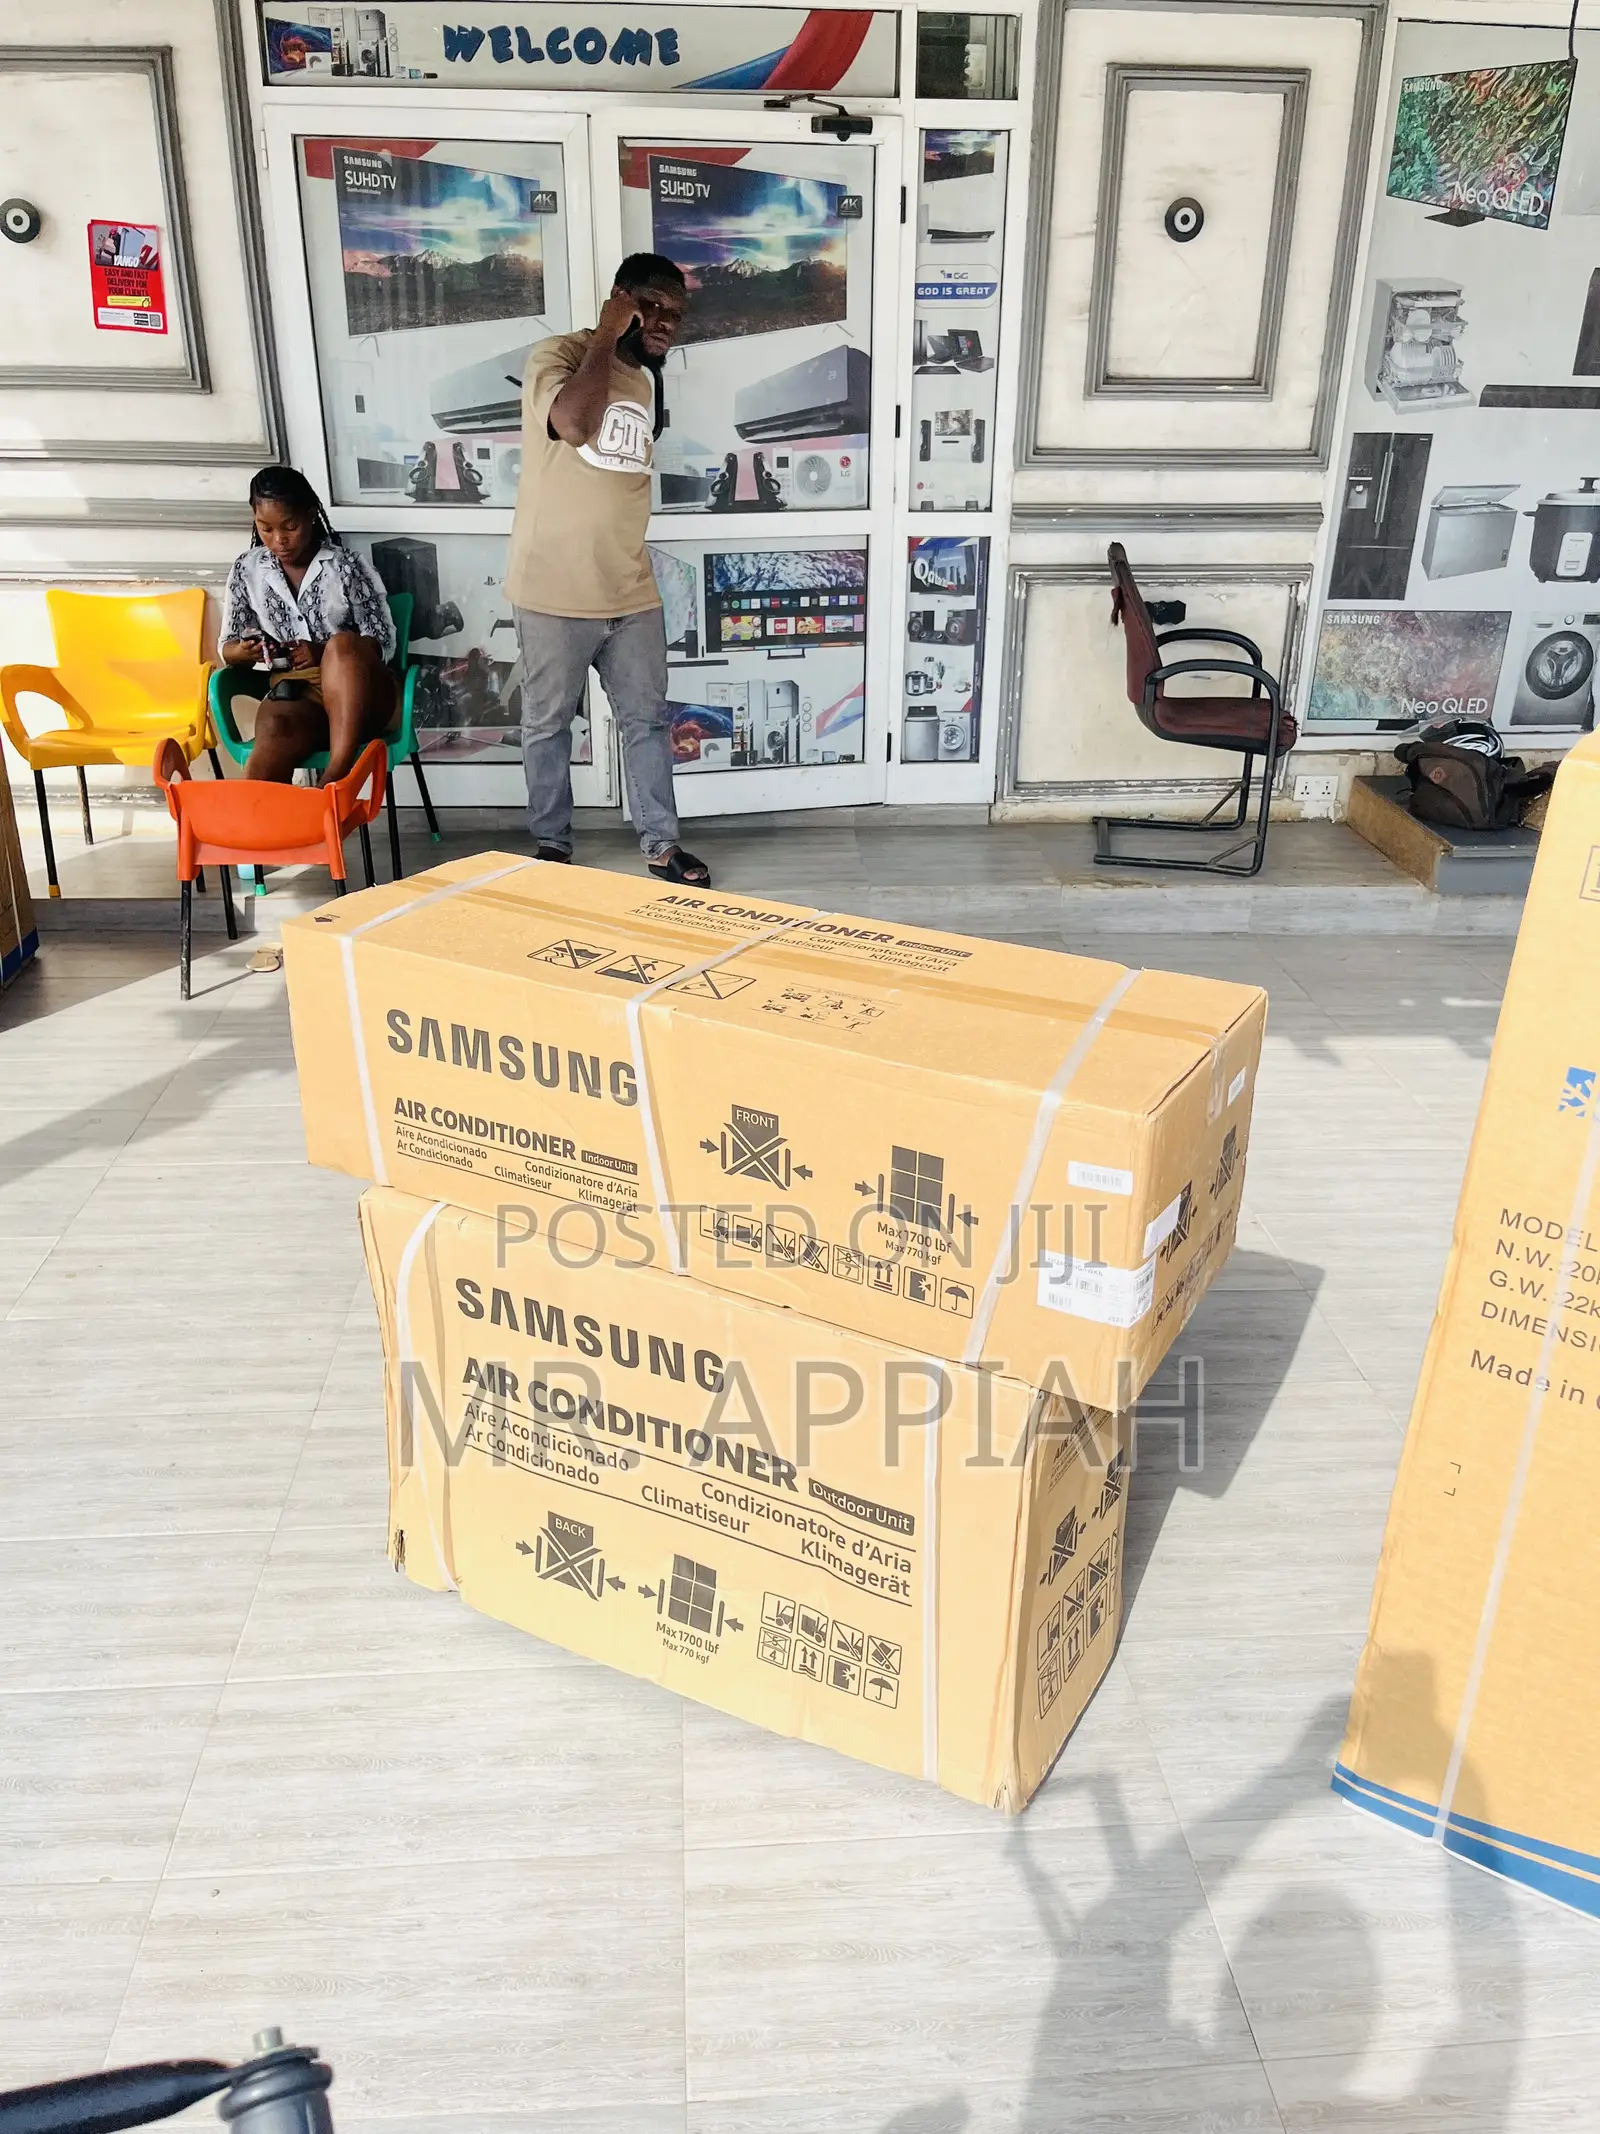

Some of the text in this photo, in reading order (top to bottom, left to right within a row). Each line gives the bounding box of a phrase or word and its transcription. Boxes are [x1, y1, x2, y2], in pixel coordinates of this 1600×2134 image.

[442, 24, 681, 66] WELCOME
[343, 155, 383, 169] SAMSUNG
[659, 164, 697, 177] SAMSUNG
[344, 170, 397, 190] SUHD TV
[660, 179, 711, 198] SUHD TV
[533, 193, 553, 206] 4K
[840, 198, 859, 211] 4K
[1451, 181, 1544, 217] Neo QLED
[104, 268, 149, 280] EASY AND FAST
[113, 254, 140, 268] YANGO
[107, 277, 148, 288] DELIVERY FOR
[108, 287, 124, 296] YOUR
[917, 287, 990, 296] GOD IS GREAT
[1326, 614, 1381, 625] SAMSUNG
[1400, 697, 1488, 714] Neo QLED
[640, 904, 761, 931] Aire Acondicionado
[646, 911, 731, 932] Condicionado
[656, 895, 705, 909] AIR
[706, 904, 895, 944] CONDITIONER
[808, 936, 912, 959] Condizionatore
[387, 1009, 638, 1106] SAMSUNG
[736, 1109, 776, 1129] FRONT
[394, 1097, 635, 1173] AIR CONDITIONER Indoor Unit
[396, 1126, 488, 1159] Aire Acondicionado
[397, 1139, 473, 1168] Ar Condicionado
[494, 1166, 552, 1190] Climatiseur
[525, 1161, 604, 1190] Condizionatore
[578, 1188, 638, 1213] Klimagerät
[877, 1221, 952, 1253] Max 1700 lbf
[1500, 1208, 1599, 1252] MODEL
[885, 1239, 942, 1265] Max 770 kgf
[455, 1278, 725, 1393] SAMSUNG
[1480, 1300, 1600, 1352] DIMENSI
[1470, 1349, 1550, 1392] Made
[1559, 1379, 1586, 1404] in
[462, 1356, 911, 1532] AIR CONDITIONER Outdoor Unit
[465, 1402, 629, 1472] Aire Acondicionado
[465, 1424, 599, 1485] Ar Condicionado
[641, 1485, 750, 1534] Climatiseur
[702, 1481, 846, 1549] Condizionatore
[555, 1517, 586, 1539] BACK
[801, 1538, 911, 1598] Klimagerät
[656, 1621, 720, 1654] Max 1700 lbf
[662, 1638, 710, 1664] Max 770 kgf
[769, 1649, 777, 1661] 4
